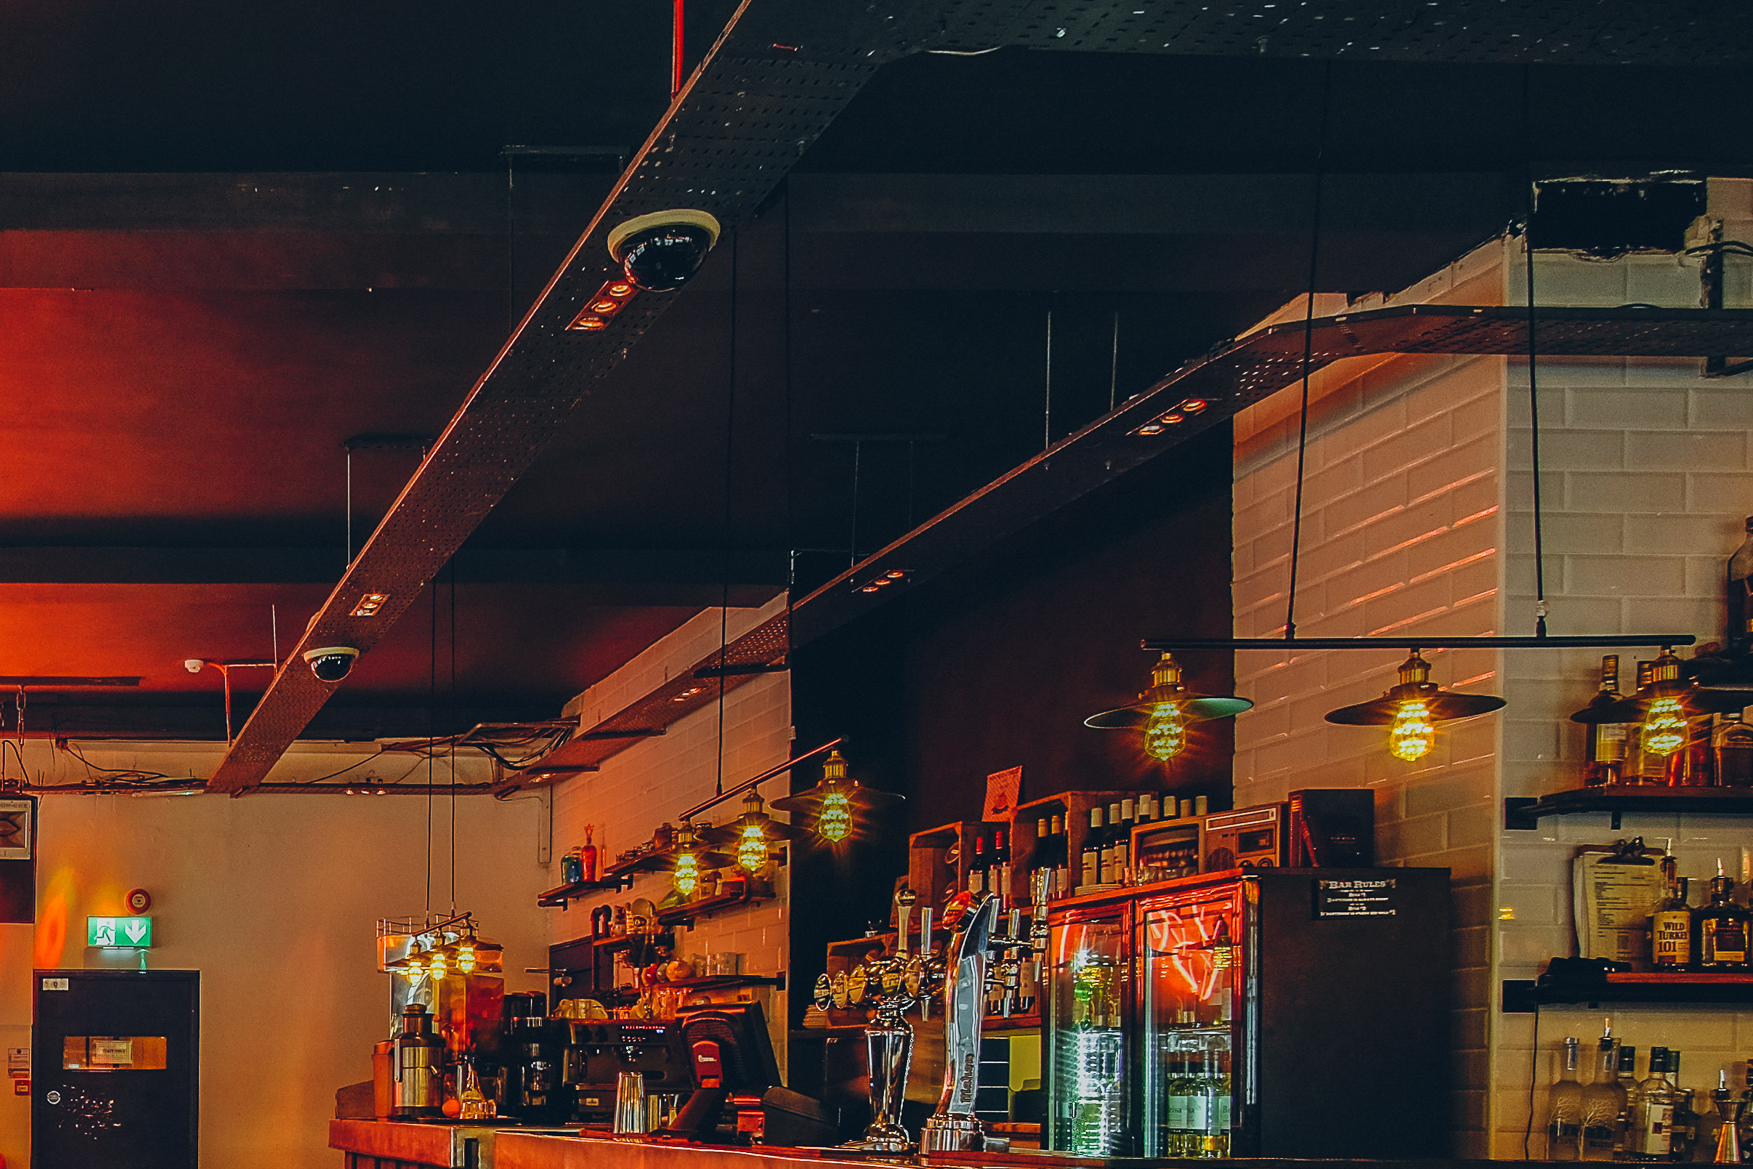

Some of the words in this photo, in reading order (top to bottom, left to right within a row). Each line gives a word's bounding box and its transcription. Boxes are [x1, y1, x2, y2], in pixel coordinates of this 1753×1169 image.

[1328, 881, 1353, 889] BAR
[1353, 880, 1386, 889] RULES
[1663, 922, 1685, 931] WILD
[1657, 930, 1688, 940] TURKE
[1657, 941, 1677, 953] 101
